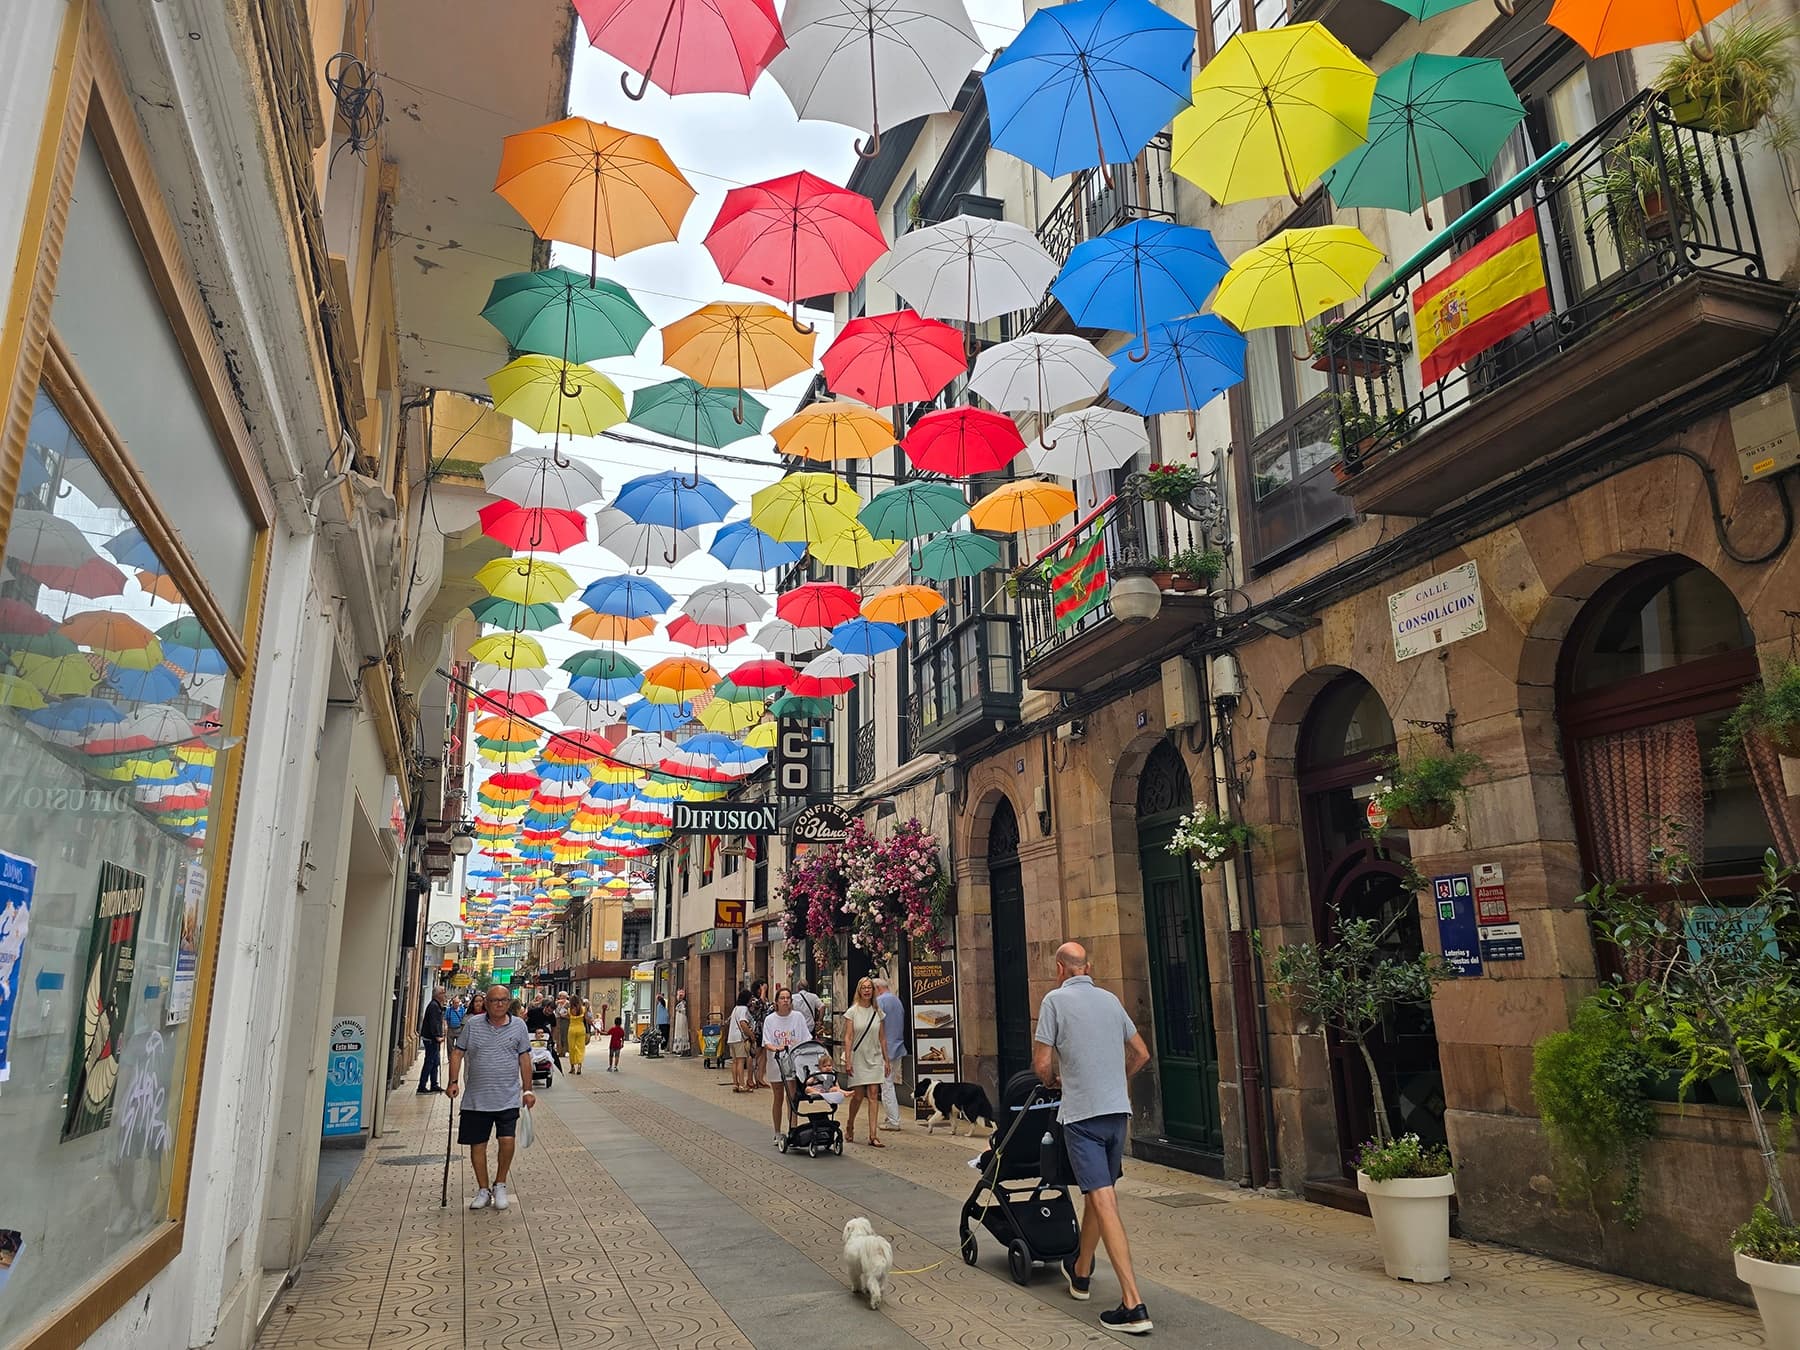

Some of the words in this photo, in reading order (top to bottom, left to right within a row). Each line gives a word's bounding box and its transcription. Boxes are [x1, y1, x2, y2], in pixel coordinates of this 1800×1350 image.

[1416, 581, 1449, 602] CALLE
[1398, 593, 1476, 633] CONSOLACION
[676, 804, 777, 830] DIFUSION
[795, 803, 854, 835] CONFITERI
[804, 817, 849, 839] Blanco
[1479, 888, 1504, 898] Alarma
[913, 975, 952, 994] Blanco
[774, 1029, 796, 1038] Good
[327, 1106, 359, 1124] 12
